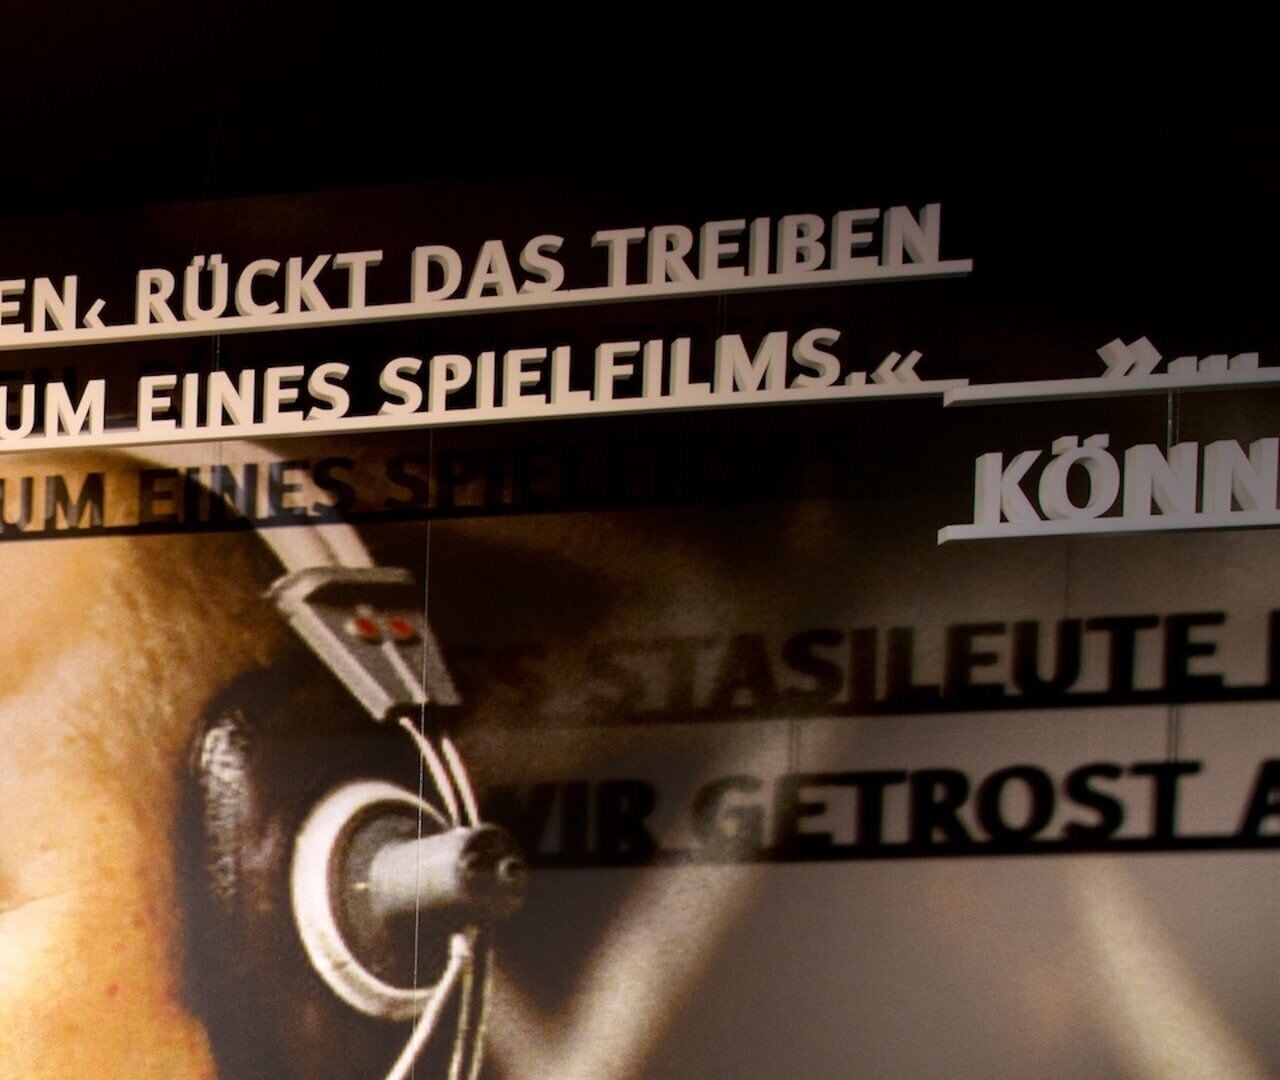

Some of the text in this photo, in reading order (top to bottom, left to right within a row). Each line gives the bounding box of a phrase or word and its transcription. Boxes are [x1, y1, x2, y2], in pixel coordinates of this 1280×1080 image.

[136, 250, 382, 324] RÜCKT
[413, 236, 565, 304] DAS
[592, 204, 943, 288] TREIBEN
[138, 362, 352, 431] EINES
[972, 434, 1280, 525] KÖNN
